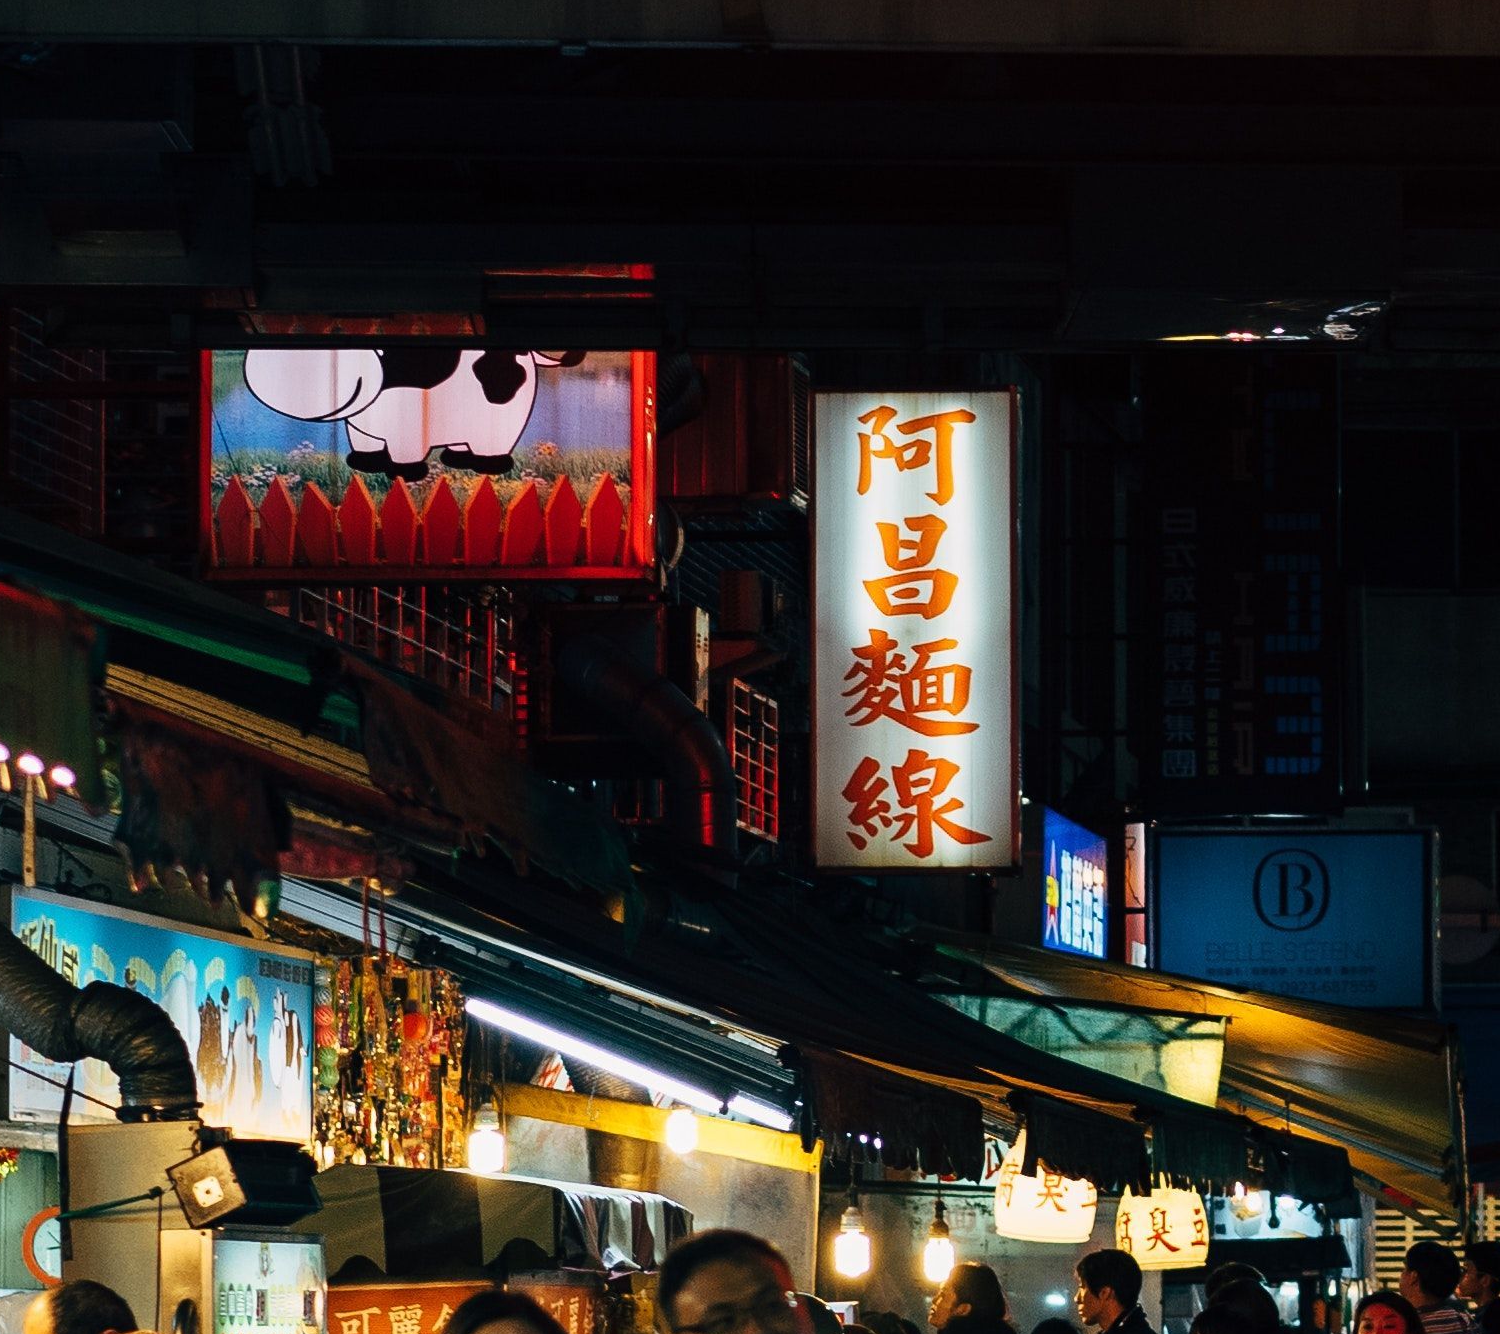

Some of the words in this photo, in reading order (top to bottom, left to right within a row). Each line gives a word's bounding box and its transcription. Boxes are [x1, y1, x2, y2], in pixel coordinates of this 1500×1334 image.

[840, 403, 992, 860] 阿昌麵線
[1263, 352, 1323, 776] LIAM
